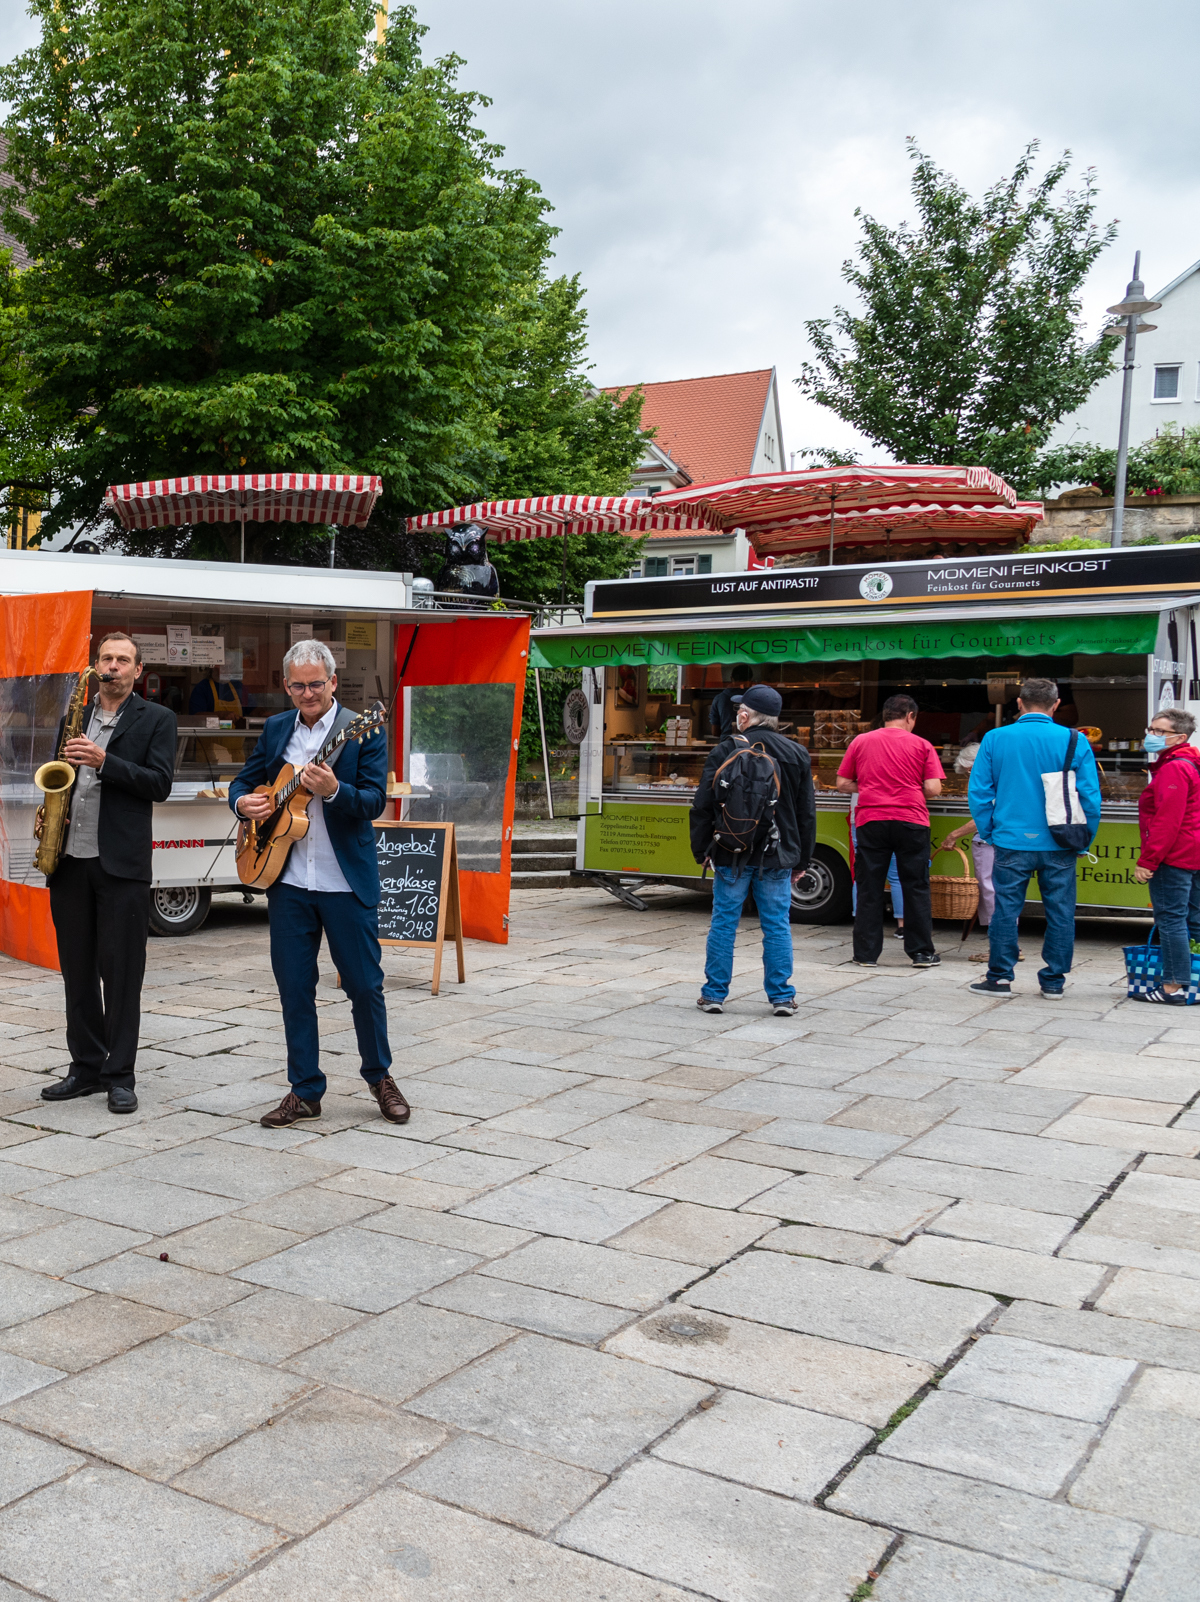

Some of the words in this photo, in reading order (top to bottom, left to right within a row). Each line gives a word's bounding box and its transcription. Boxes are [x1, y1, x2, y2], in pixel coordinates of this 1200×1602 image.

[863, 572, 889, 583] MOMENI
[927, 566, 1008, 580] MOMENI
[1011, 559, 1111, 576] FEINKOST
[711, 582, 736, 593] LUST
[738, 581, 759, 592] AUF
[760, 577, 819, 591] ANTIPASTI?
[927, 582, 968, 592] Feinkost
[971, 580, 986, 590] für
[989, 579, 1041, 589] Gourmets
[864, 590, 889, 600] FEINKOST
[570, 641, 671, 659] MOMENI
[677, 638, 806, 657] FEINKOST
[822, 635, 904, 653] Feinkost
[912, 633, 942, 650] für
[950, 632, 1057, 649] Gourmets
[567, 691, 587, 710] MOMENI
[600, 814, 639, 822] MOMENI
[639, 816, 685, 824] FEINKOST
[376, 831, 436, 857] Angebot
[617, 832, 677, 841] Ammerbuch-Entringen
[379, 865, 436, 893] ergkäse
[405, 894, 438, 917] 1,68
[402, 920, 434, 938] 2,48
